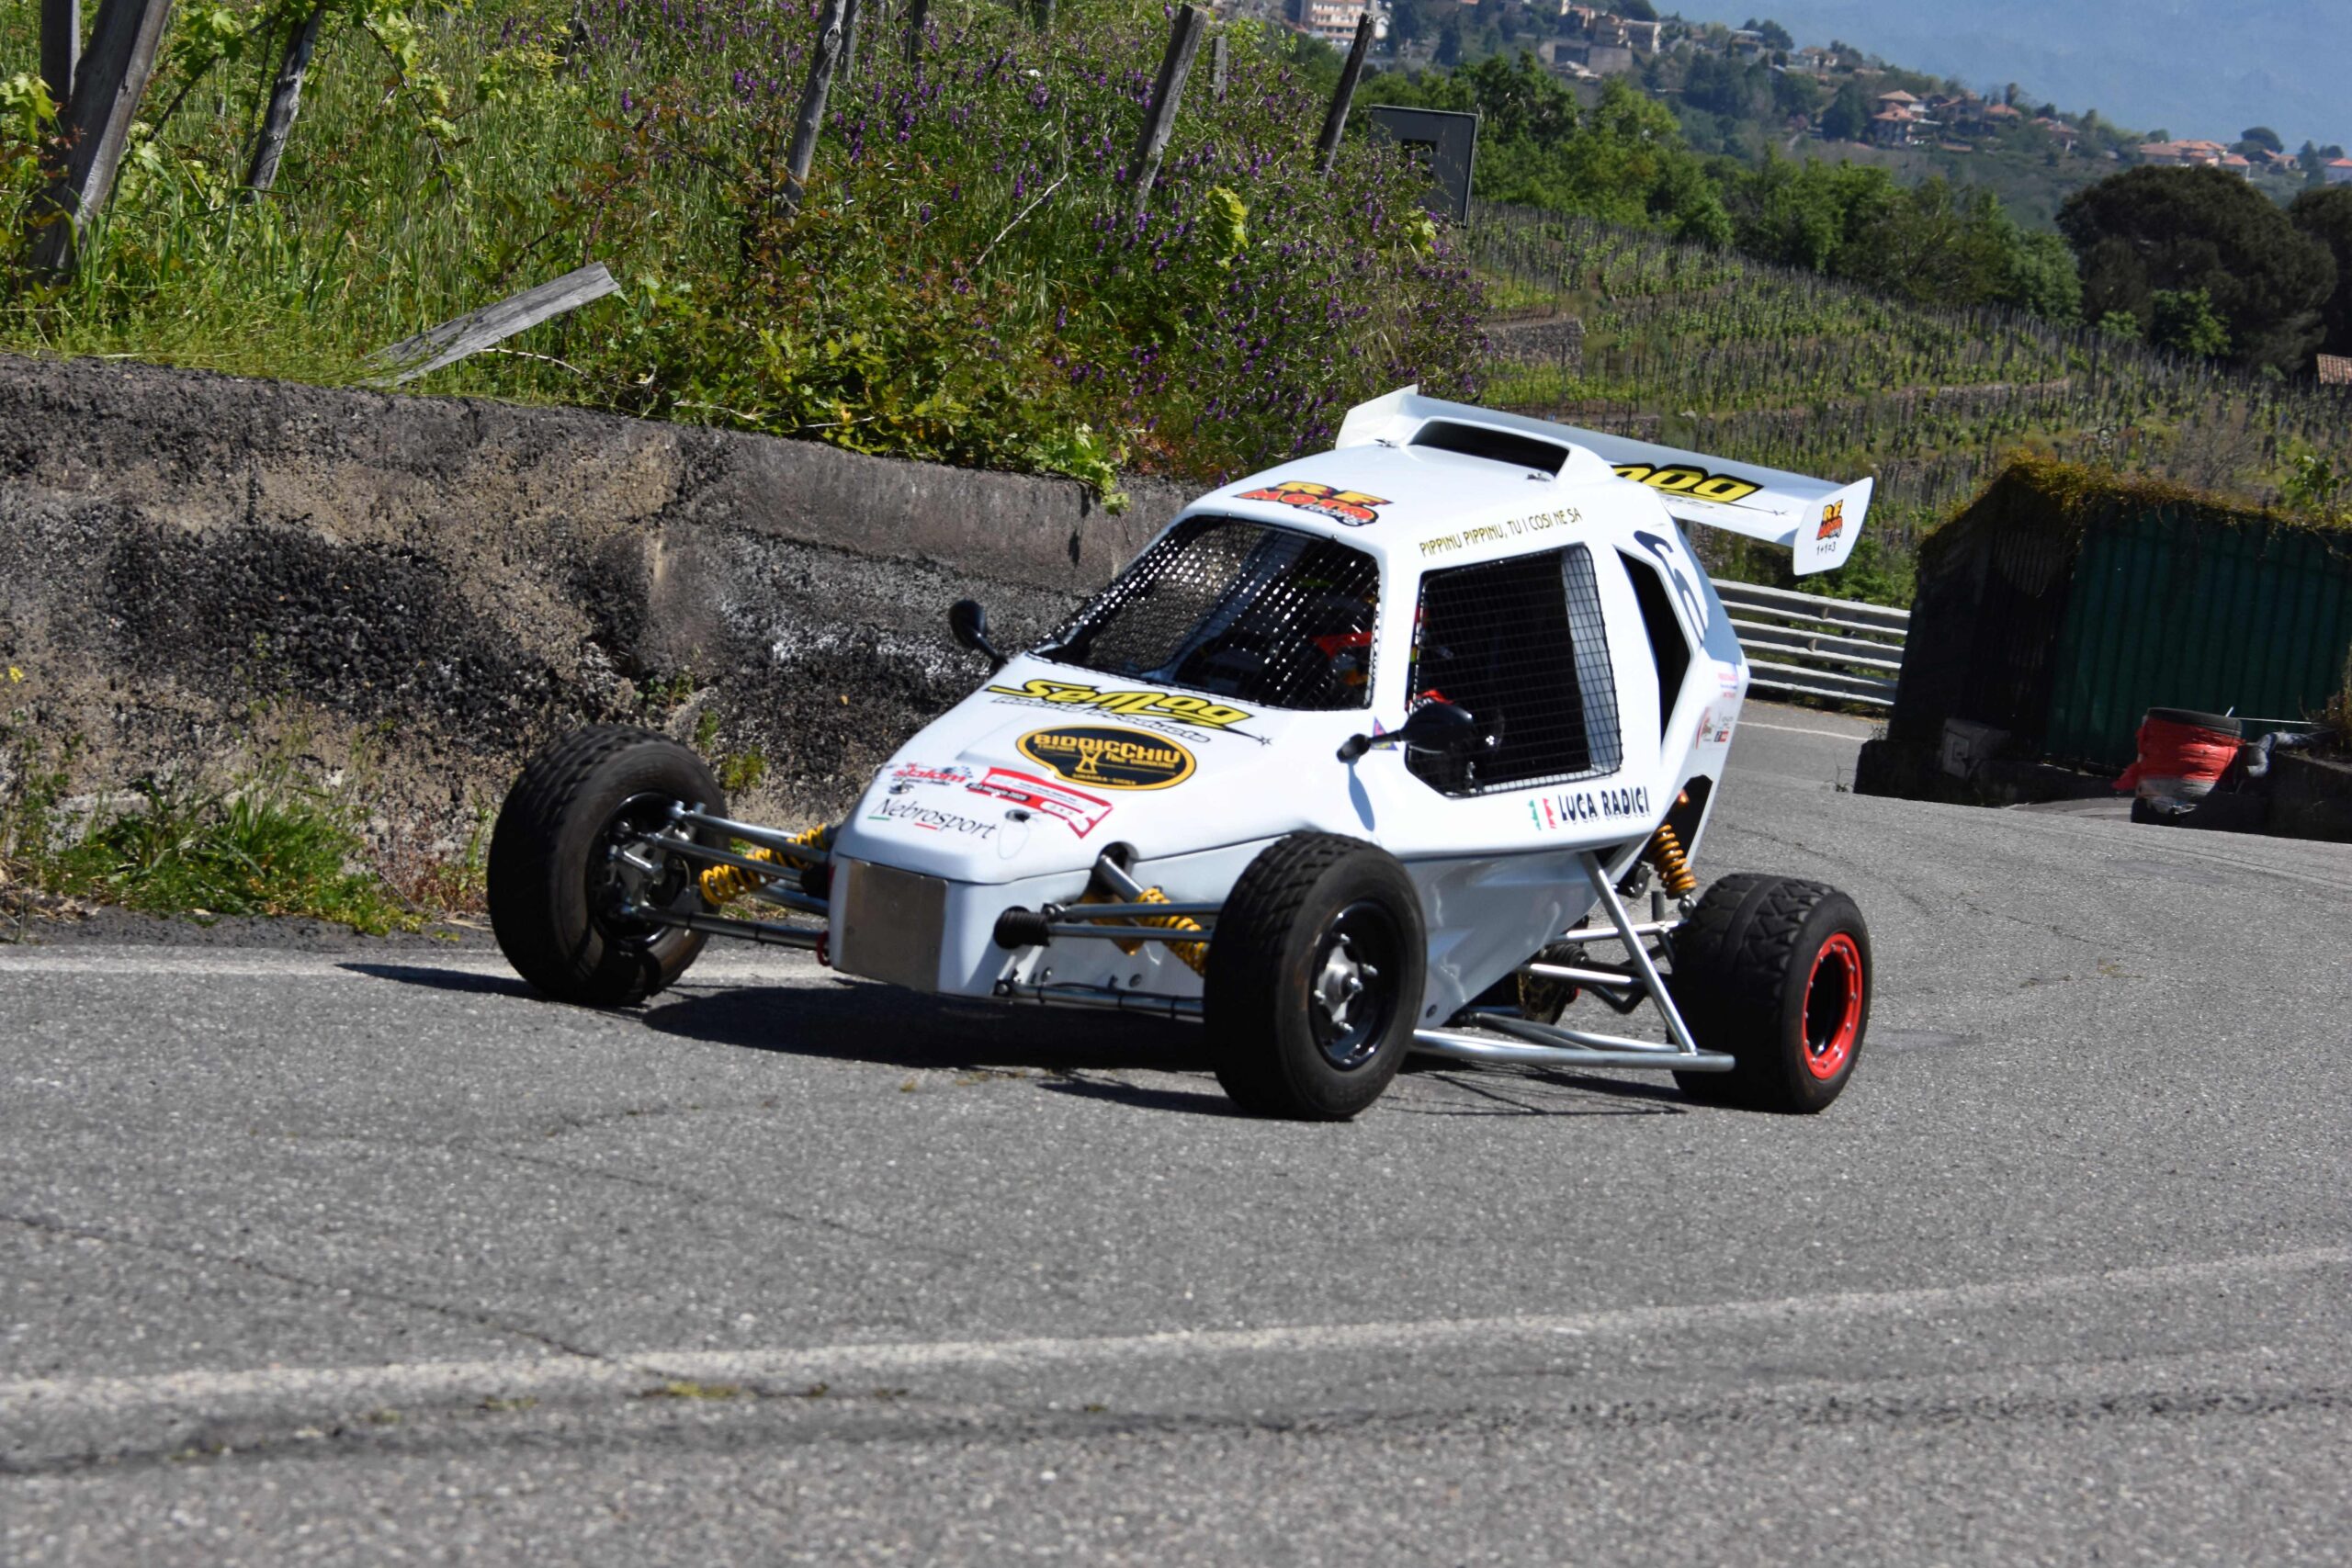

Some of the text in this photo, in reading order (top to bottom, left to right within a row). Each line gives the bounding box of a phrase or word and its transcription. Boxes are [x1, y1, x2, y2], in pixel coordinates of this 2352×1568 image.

[1235, 489, 1377, 521] MOTO
[1419, 534, 1463, 557] PIPPINU
[1463, 525, 1508, 546] PIPPINU,
[1507, 519, 1522, 535] TU
[870, 798, 998, 840] Nebrosport
[1558, 785, 1651, 822] LUCA RADICI
